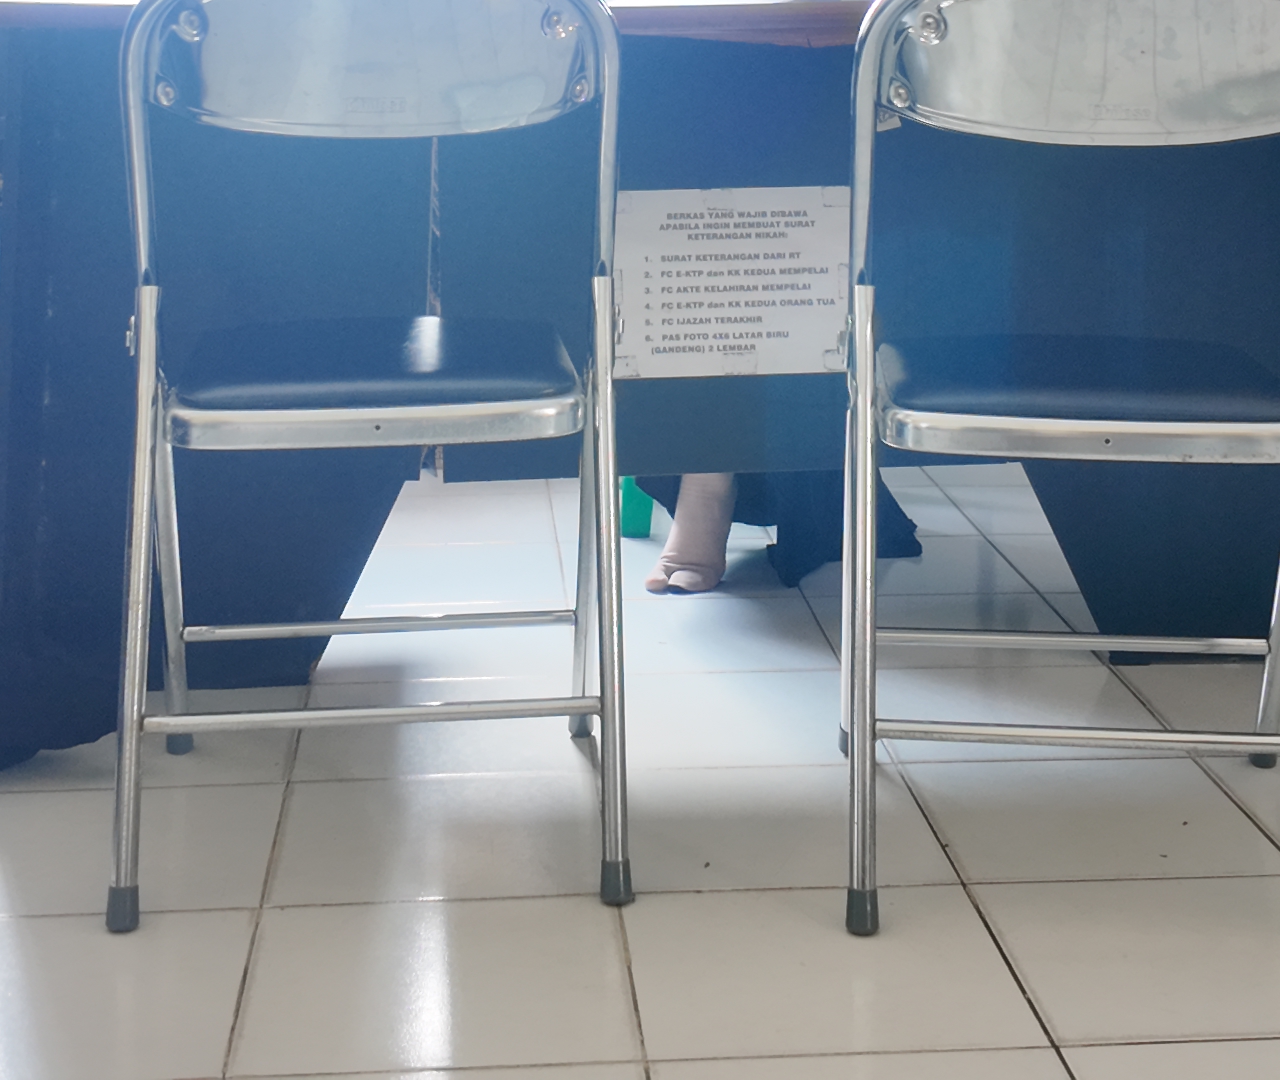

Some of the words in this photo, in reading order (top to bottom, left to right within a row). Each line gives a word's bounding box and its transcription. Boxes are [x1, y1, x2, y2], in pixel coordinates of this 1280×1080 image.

[666, 212, 705, 221] BERKAS
[708, 211, 735, 219] YANG
[737, 210, 768, 219] WAJIB
[770, 210, 808, 218] DIBAWA
[659, 223, 700, 231] APABILA
[703, 222, 730, 230] INGIN
[733, 221, 780, 229] MEMBUAT
[784, 220, 816, 228] SURAT
[687, 232, 752, 241] KETERANGAN
[755, 231, 788, 239] NIKAH:
[661, 254, 693, 263] SURAT
[695, 253, 760, 262] KETERANGAN
[763, 252, 786, 260] DARI
[788, 251, 801, 260] RT
[661, 270, 673, 278] FC
[676, 269, 704, 278] E-KTP
[706, 269, 724, 277] dan
[727, 269, 740, 277] KK
[743, 268, 776, 276] KEDUA
[779, 266, 829, 275] MEMPELAI
[661, 285, 673, 294] FC
[676, 285, 701, 293] AKTE
[704, 284, 759, 293] KELAHIRAN
[761, 283, 811, 291] MEMPELAI
[661, 301, 673, 310] FC
[676, 301, 705, 309] E-KTP
[707, 300, 725, 309] dan
[728, 300, 741, 308] KK
[744, 299, 777, 308] KEDUA
[779, 298, 814, 307] ORANG
[816, 298, 836, 306] TUA
[661, 317, 674, 326] FC
[676, 317, 712, 325] IJAZAH
[714, 316, 763, 324] TERAKHIR
[662, 333, 681, 342] PAS
[684, 332, 709, 341] FOTO
[732, 332, 763, 340] LATAR
[766, 331, 790, 339] BIRU
[651, 345, 705, 355] (GANDENG)
[708, 345, 714, 353] 2
[716, 344, 756, 352] LEMBAR
